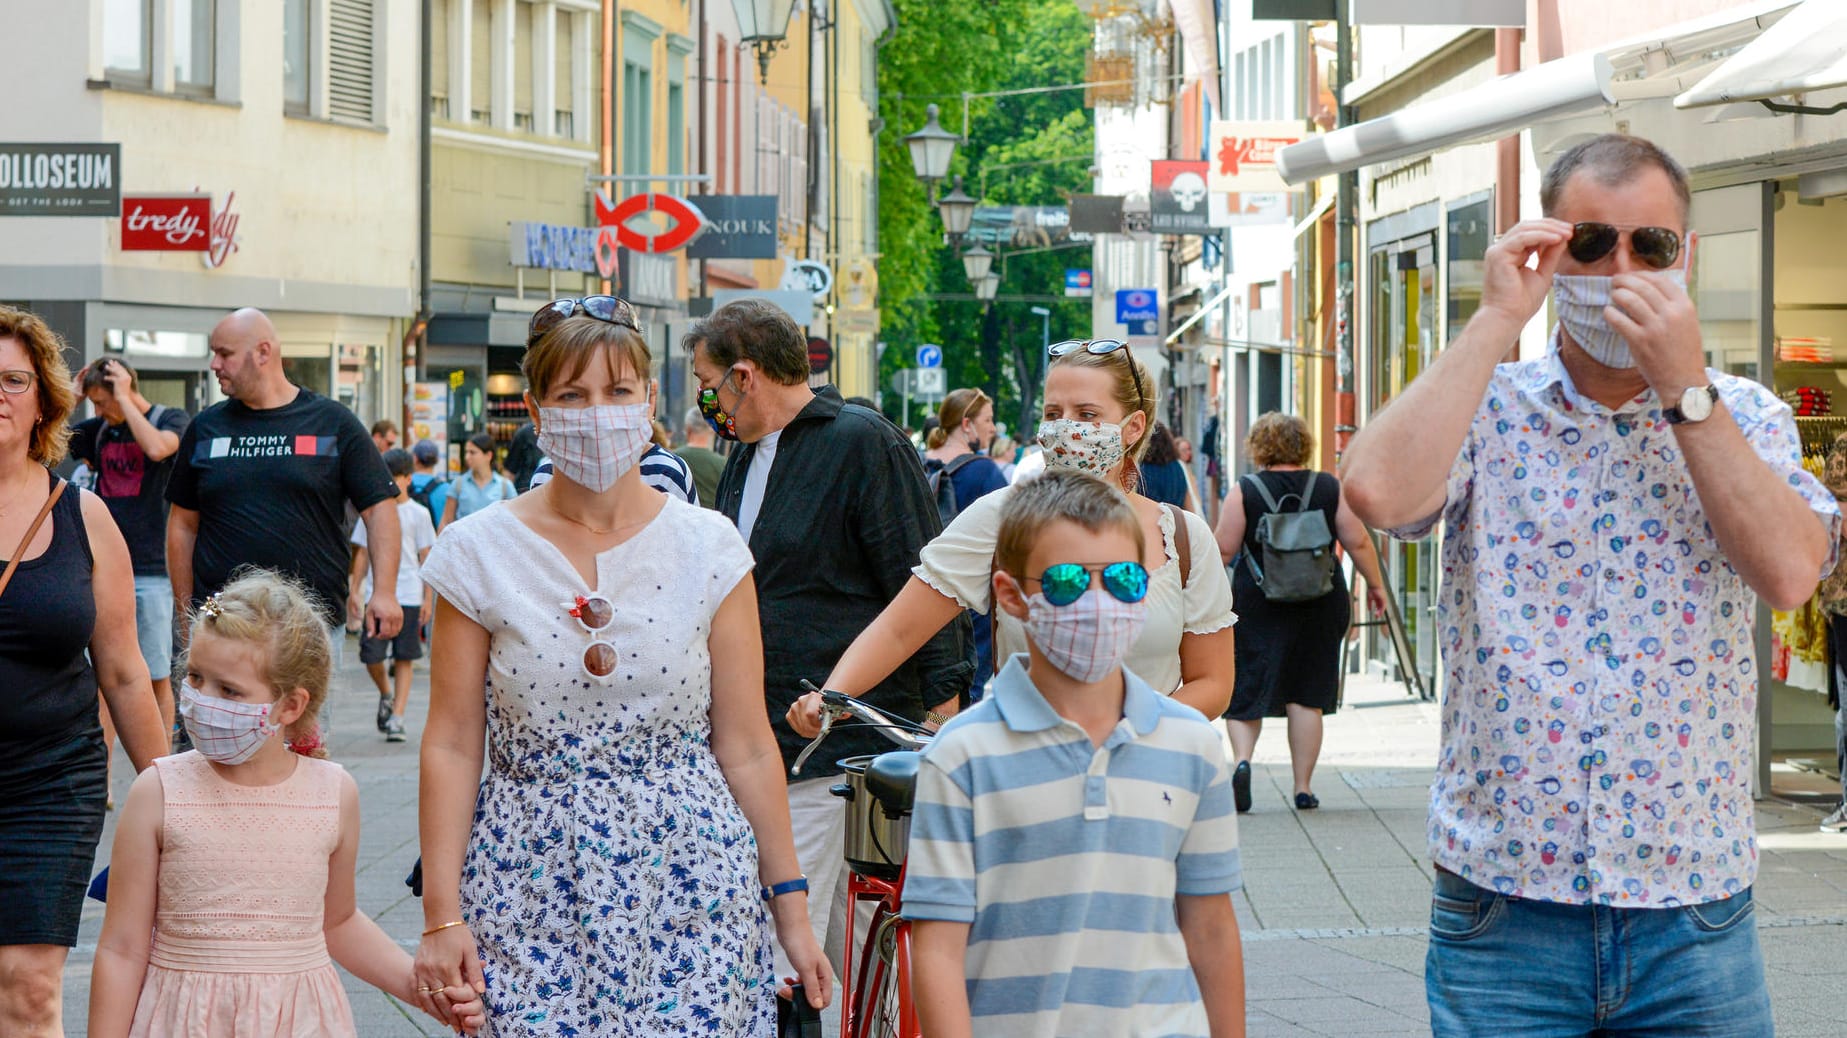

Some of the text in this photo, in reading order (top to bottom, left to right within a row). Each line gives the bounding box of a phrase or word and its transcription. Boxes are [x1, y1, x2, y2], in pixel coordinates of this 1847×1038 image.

[8, 198, 83, 207] GET THE LOOK
[126, 205, 206, 244] tredy
[704, 219, 773, 235] NOUK
[239, 436, 287, 447] TOMMY
[230, 446, 293, 457] HILFIGER
